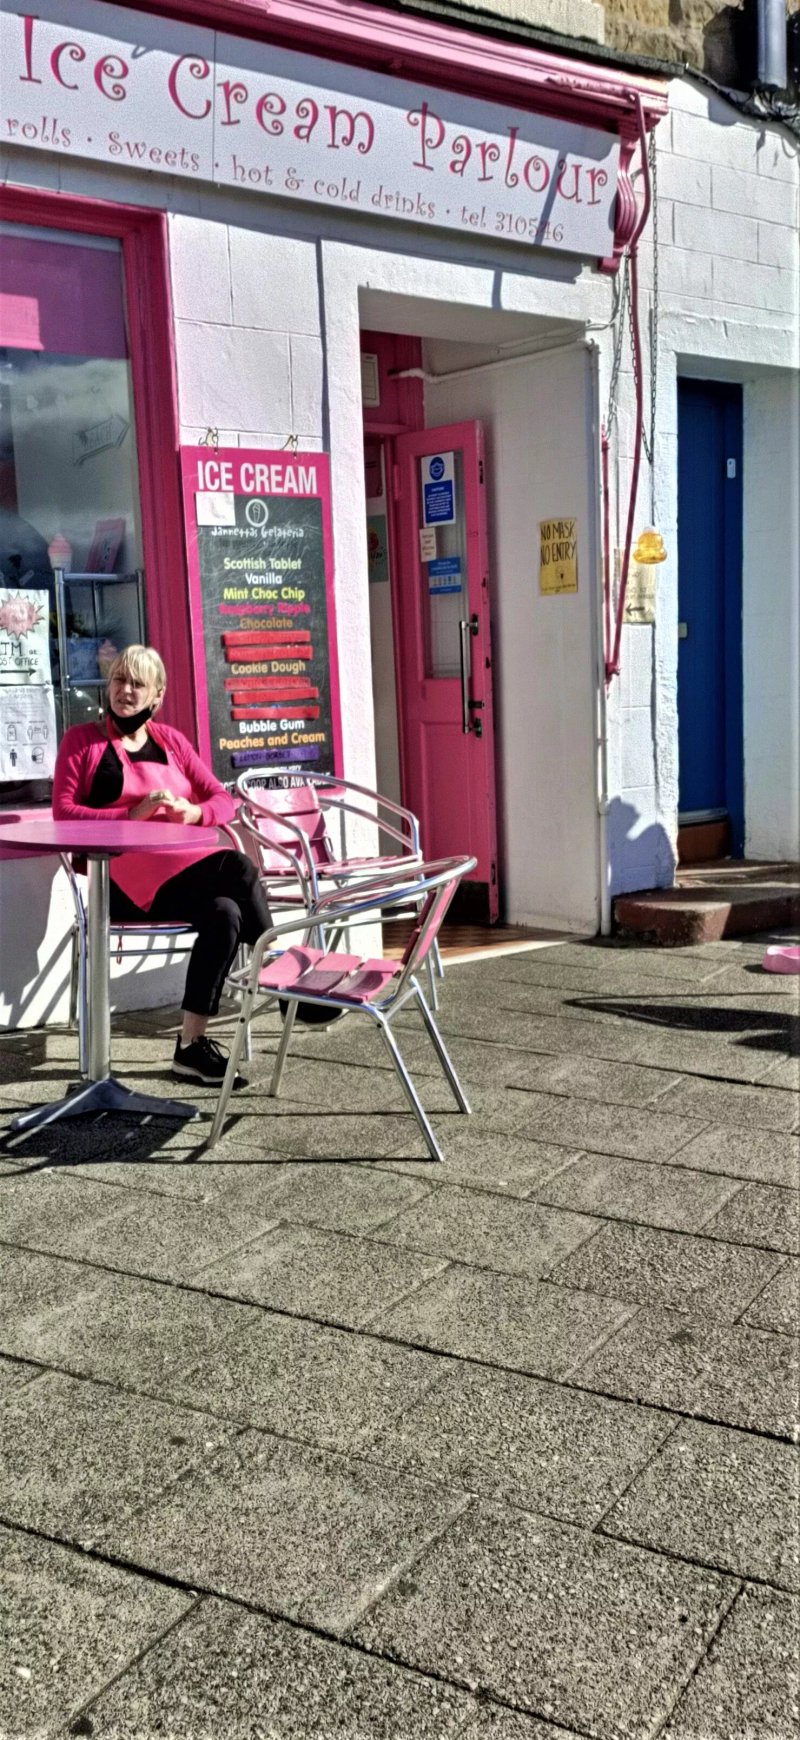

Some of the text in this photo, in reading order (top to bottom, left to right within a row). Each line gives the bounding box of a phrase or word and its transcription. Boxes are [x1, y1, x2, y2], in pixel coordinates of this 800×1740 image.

[18, 13, 608, 205] Ice Cream Parlour
[6, 116, 564, 242] rolls Sweets hot & cold drinks tel 310546
[197, 460, 317, 494] ICE CREAM
[261, 526, 304, 538] Gelateria
[541, 521, 576, 541] NO MASK
[541, 542, 576, 566] NO ENTRY
[224, 557, 302, 570] Scottish Tablet
[245, 573, 282, 584] Vanilla
[223, 587, 305, 601] Mint Choc Chip
[239, 617, 293, 628] Chocolate
[0, 642, 22, 656] TM
[15, 657, 38, 666] OFFICE
[231, 661, 306, 674] Cookie Dough
[239, 719, 305, 733] Bubble Gum
[219, 732, 325, 750] Peaches and Cream
